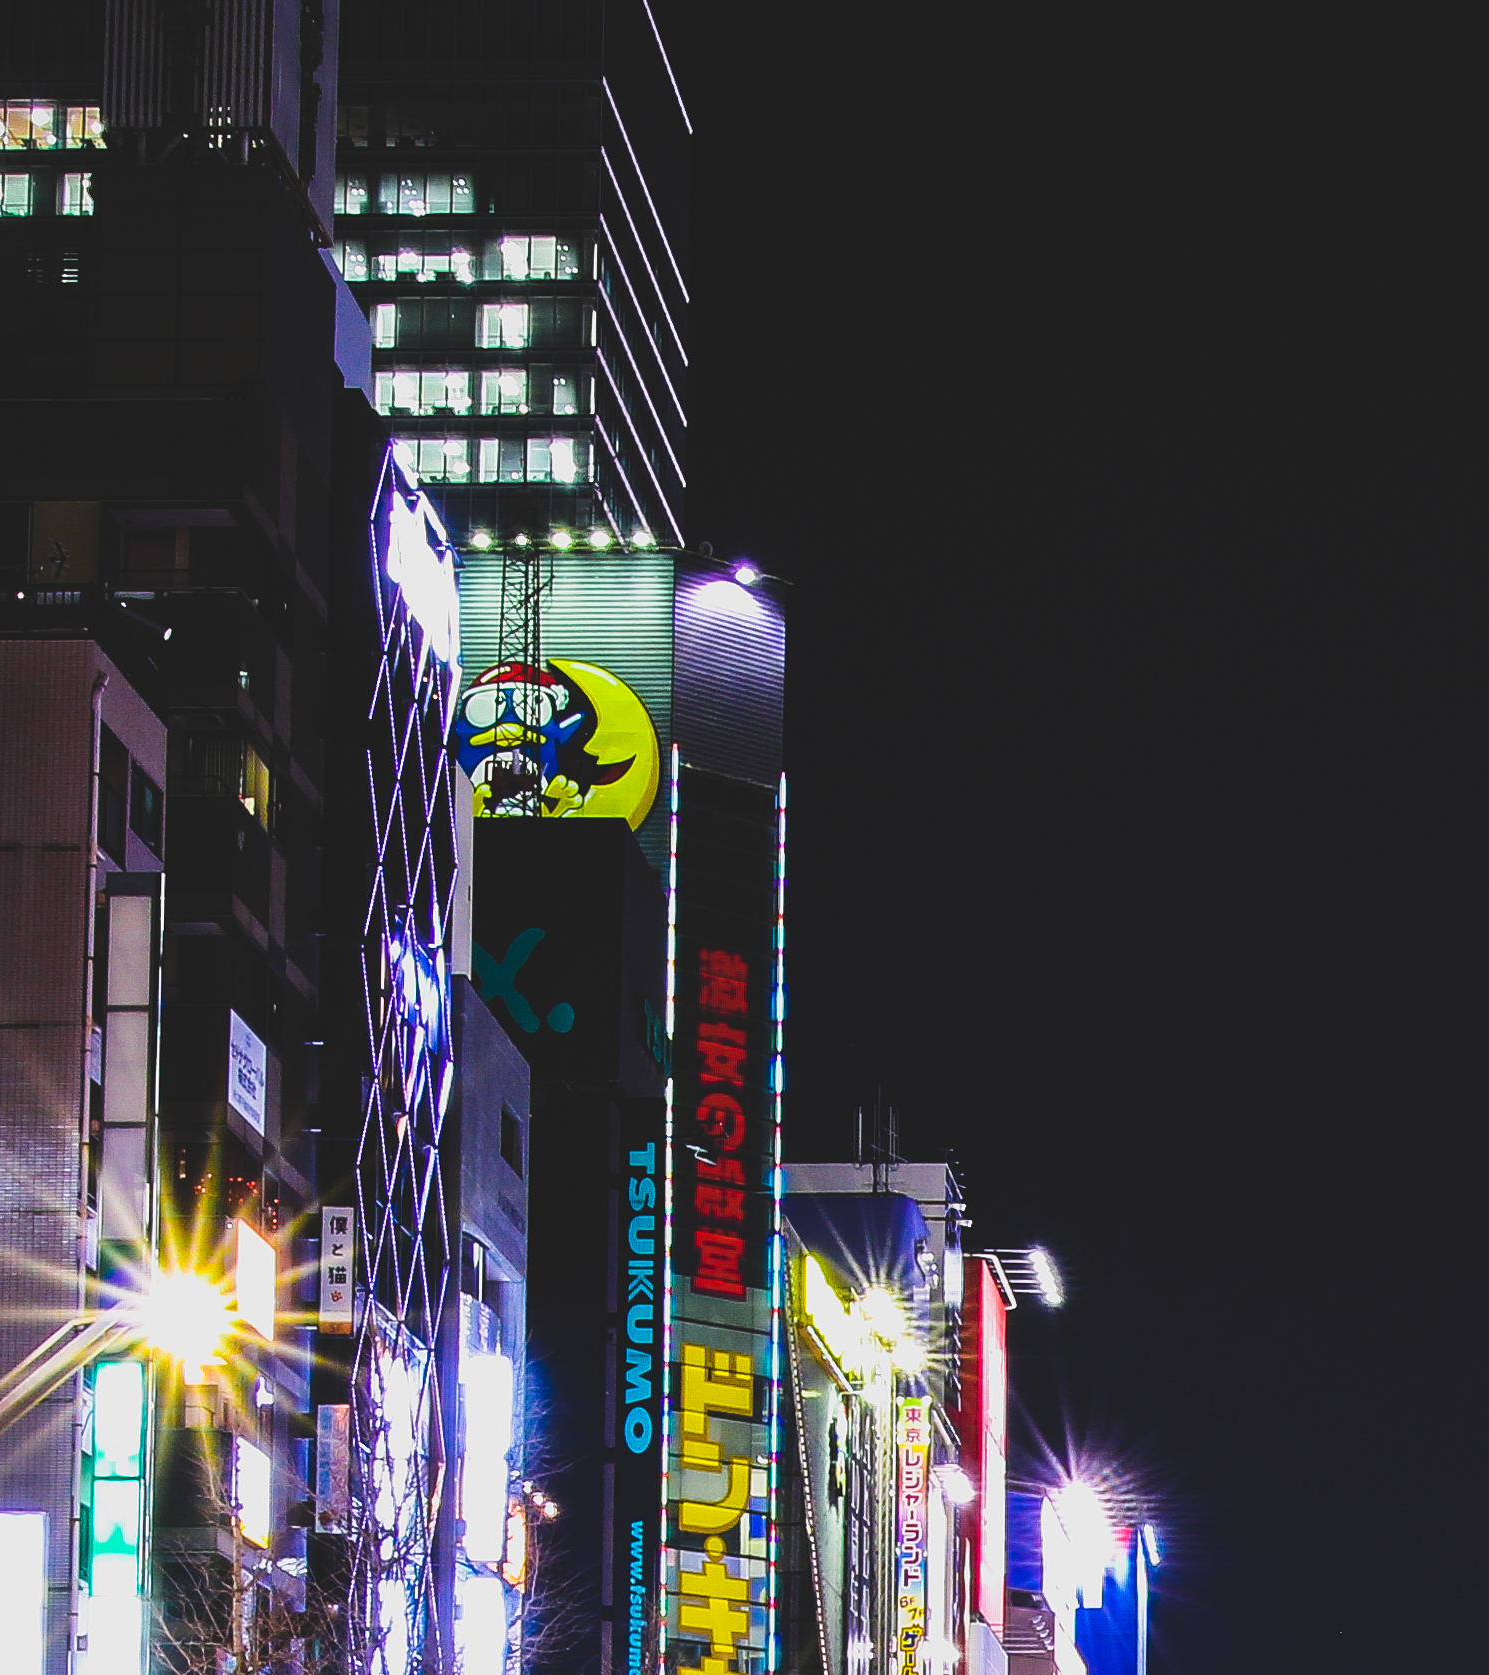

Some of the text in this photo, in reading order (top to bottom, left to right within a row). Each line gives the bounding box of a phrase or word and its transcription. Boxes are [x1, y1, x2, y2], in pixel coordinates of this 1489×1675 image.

[328, 1215, 348, 1286] 僕と猫
[624, 1142, 656, 1455] TSUKUMO
[902, 1408, 922, 1587] 東京レジャーランド
